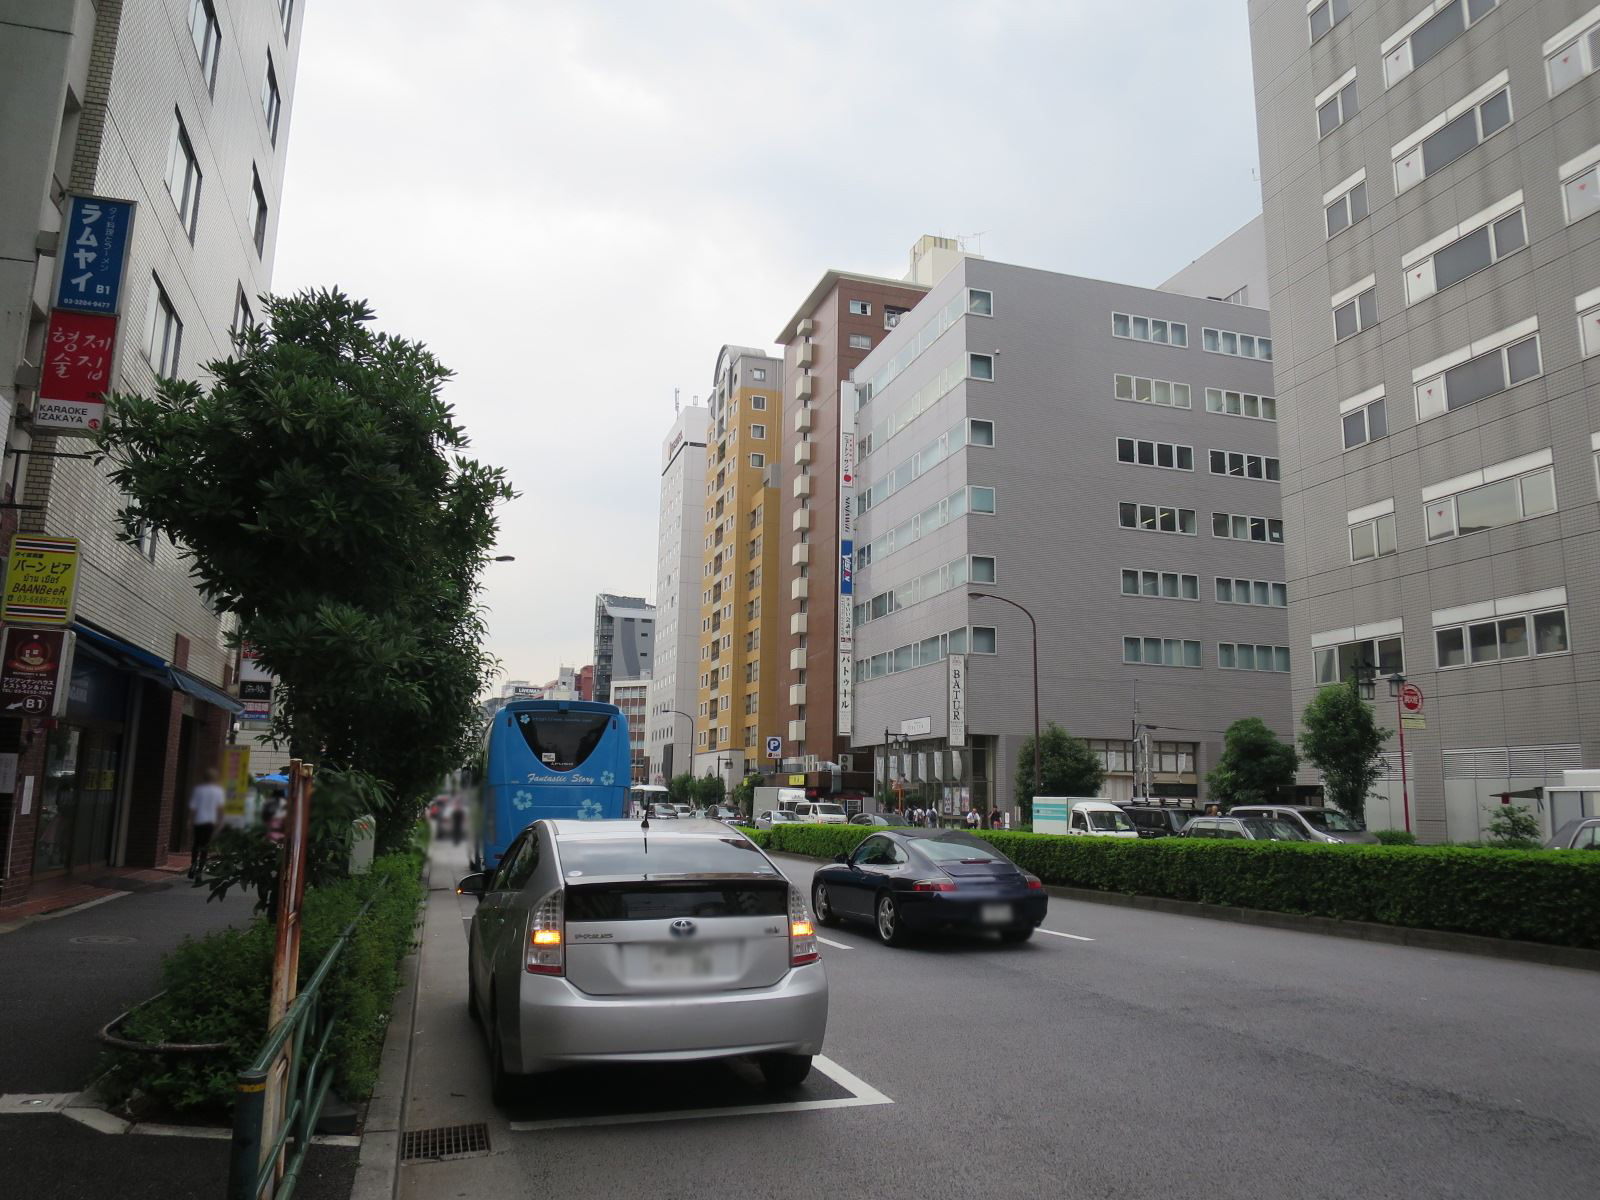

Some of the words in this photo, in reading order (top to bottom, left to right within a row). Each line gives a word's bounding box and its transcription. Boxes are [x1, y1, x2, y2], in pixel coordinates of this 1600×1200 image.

[70, 204, 102, 292] ラムヤイ
[95, 284, 111, 295] B1
[50, 352, 103, 381] 술집
[39, 404, 88, 416] KARAOKE
[38, 412, 83, 424] IZAKAYA
[841, 656, 851, 709] バトゥール
[953, 669, 961, 721] BATUR
[25, 699, 43, 709] B1
[527, 773, 568, 784] Fantastic
[571, 773, 595, 784] Story
